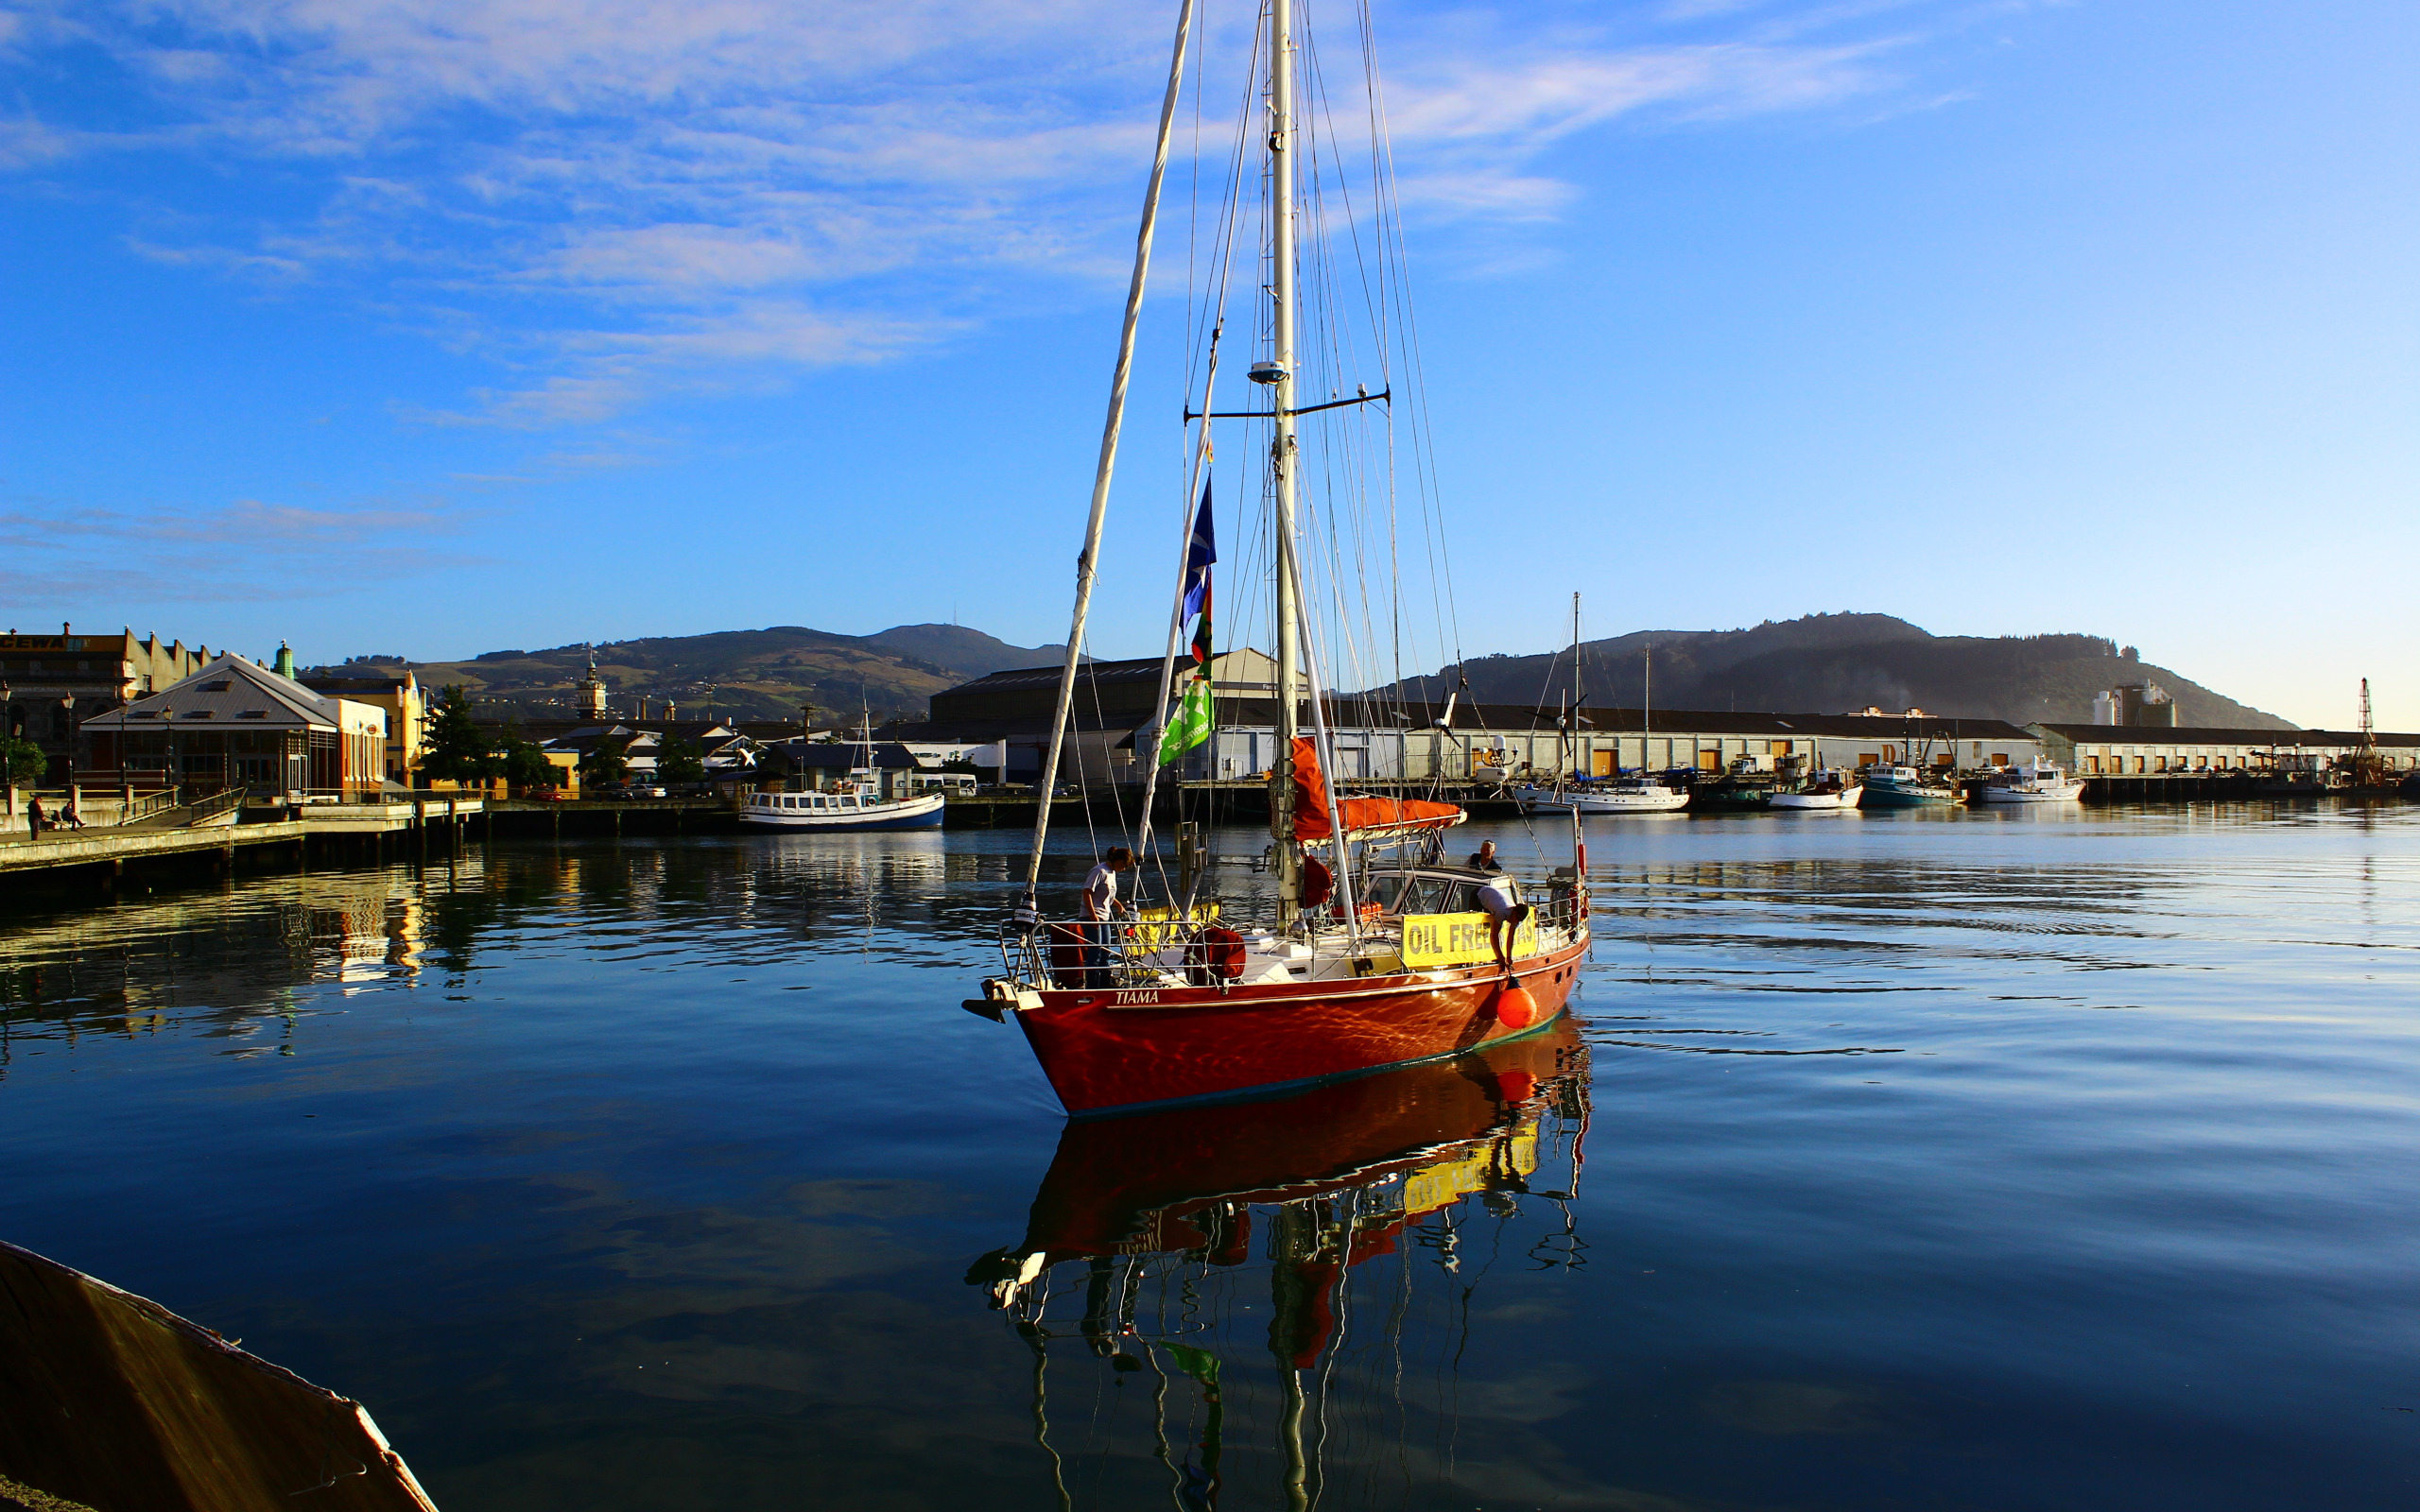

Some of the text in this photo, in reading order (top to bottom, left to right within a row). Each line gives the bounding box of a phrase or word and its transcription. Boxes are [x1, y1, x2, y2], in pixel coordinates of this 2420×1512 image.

[1409, 924, 1443, 954] OIL
[1449, 922, 1491, 952] FREE
[1116, 990, 1159, 1005] TIAMA
